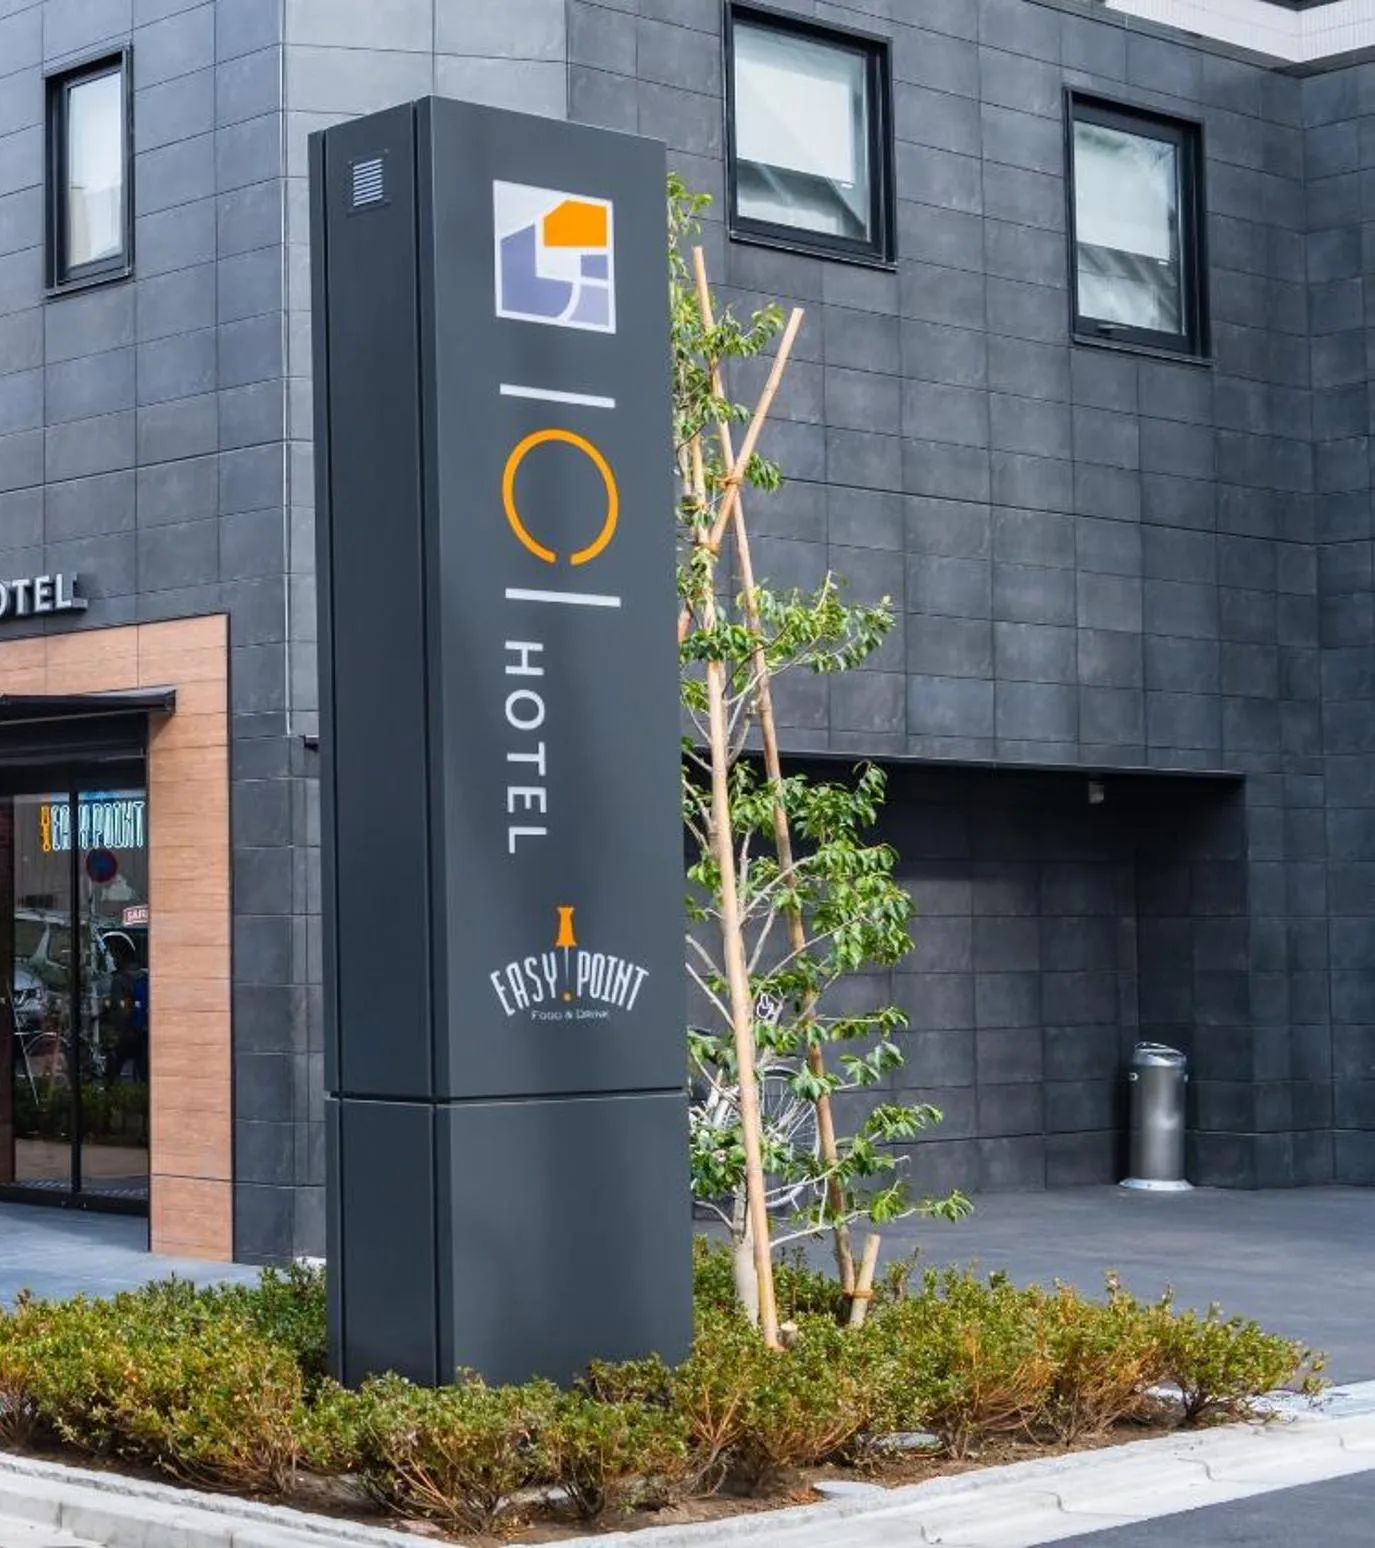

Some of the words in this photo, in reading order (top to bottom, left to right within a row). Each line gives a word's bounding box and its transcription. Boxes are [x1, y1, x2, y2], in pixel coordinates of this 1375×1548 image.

[503, 639, 548, 855] HOTEL
[51, 803, 90, 852] EAY
[489, 951, 558, 1018] EASY
[576, 950, 650, 1012] POINT
